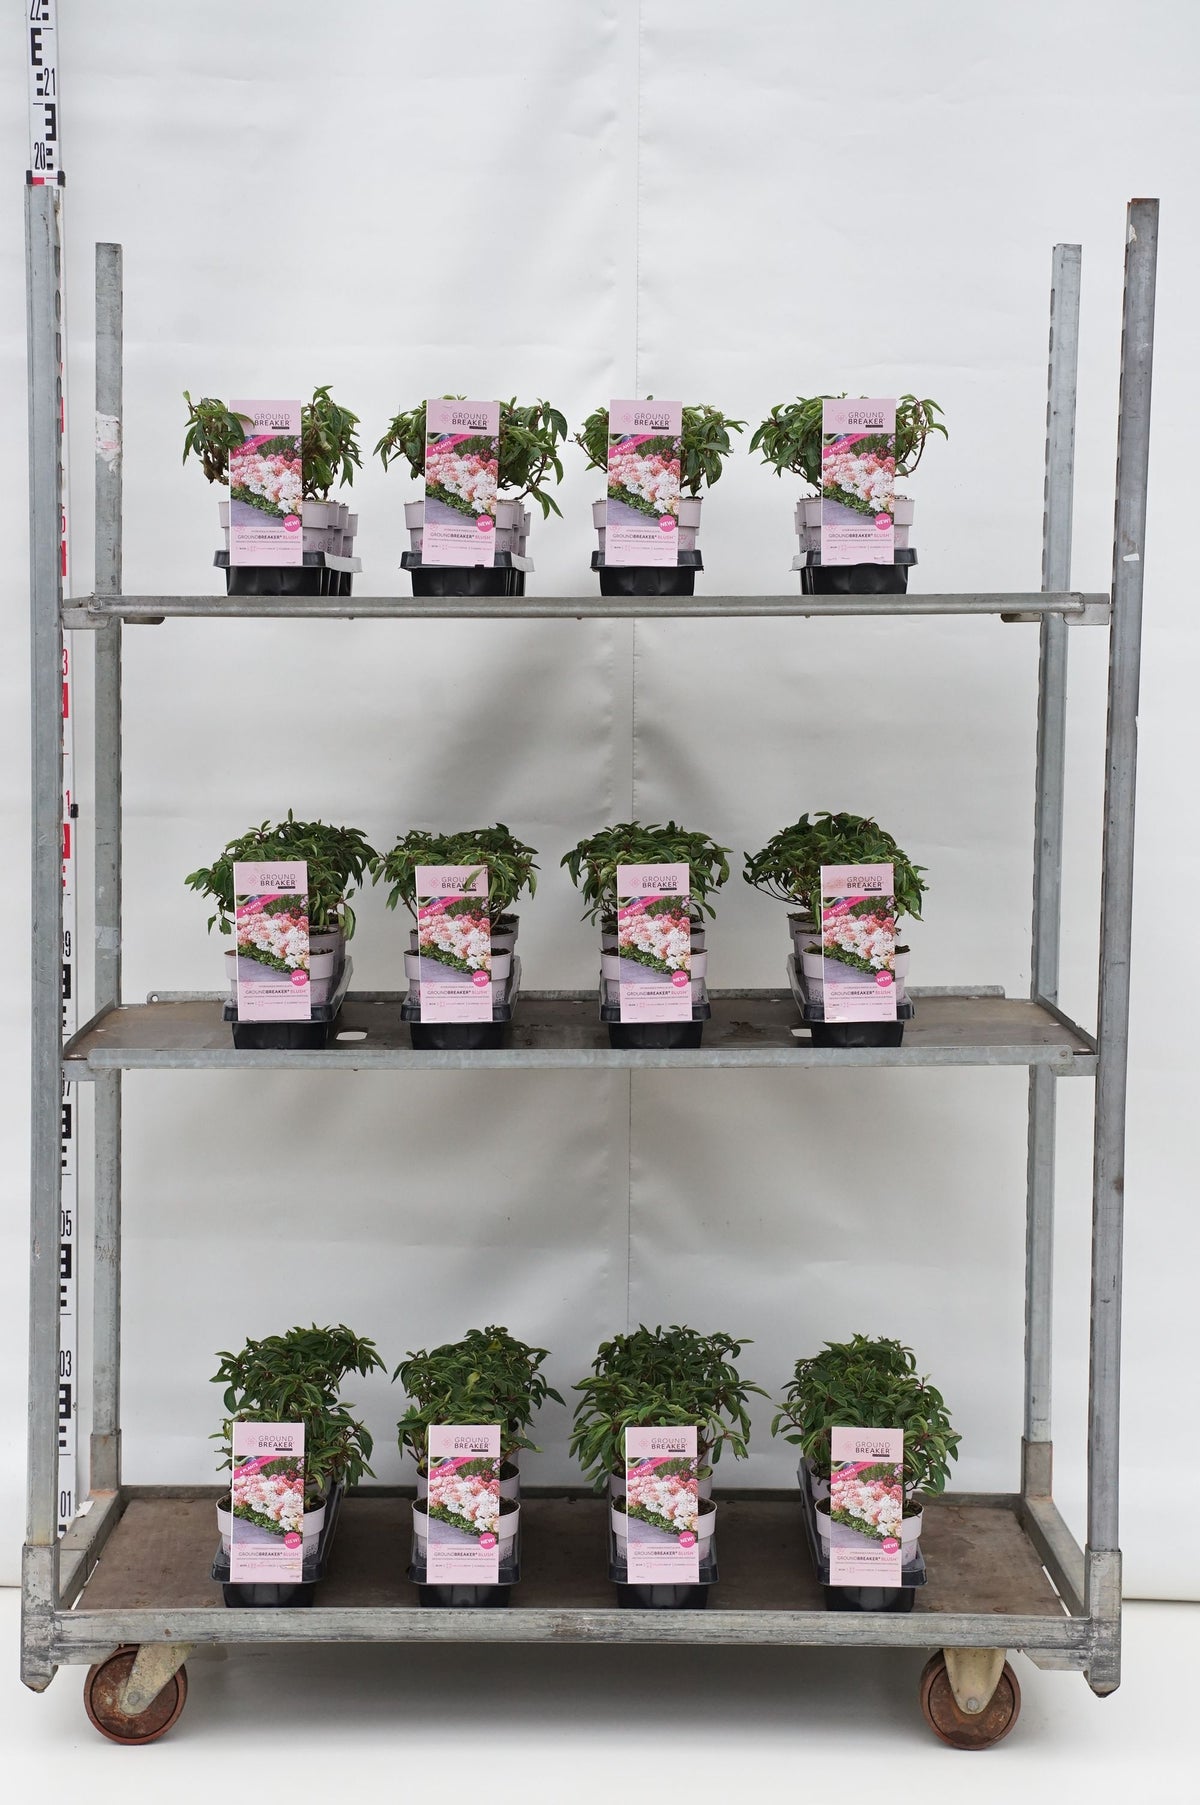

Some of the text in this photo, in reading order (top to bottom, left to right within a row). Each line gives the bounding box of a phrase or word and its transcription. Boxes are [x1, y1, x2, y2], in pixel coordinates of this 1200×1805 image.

[30, 0, 41, 21] 22
[44, 68, 56, 97] 21
[34, 142, 46, 170] 20
[673, 975, 687, 983] NEW!
[60, 1490, 71, 1517] 01
